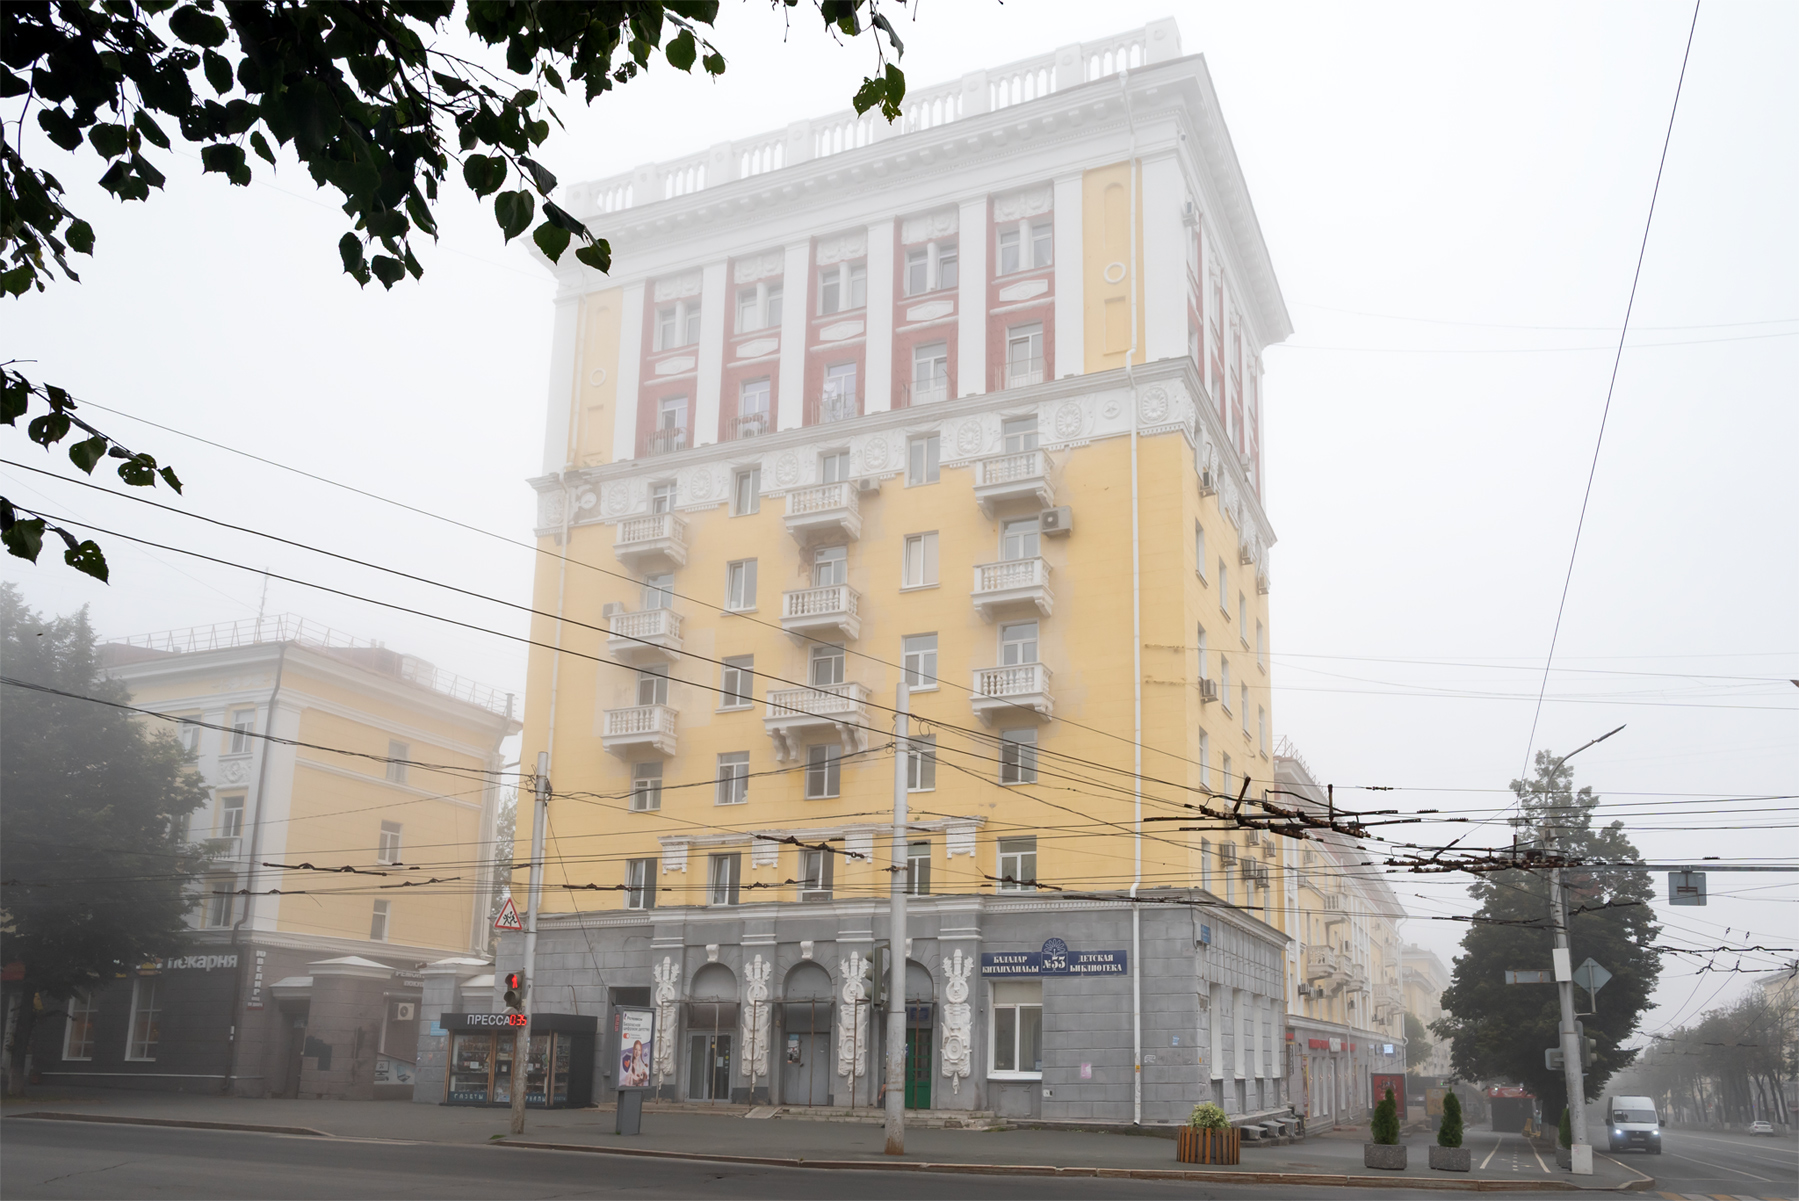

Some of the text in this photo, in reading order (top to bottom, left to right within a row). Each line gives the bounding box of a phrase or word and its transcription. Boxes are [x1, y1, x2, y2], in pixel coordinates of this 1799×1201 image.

[993, 955, 1028, 964] БАЛАЛАР
[1078, 954, 1114, 963] ДЕТСКАЯ
[1069, 963, 1122, 972] БИБЛИОТЕКА
[254, 950, 266, 995] ЮВЕЛИР
[467, 1014, 511, 1026] ПРЕССА
[454, 1092, 485, 1100] ГАЗЕТЫ
